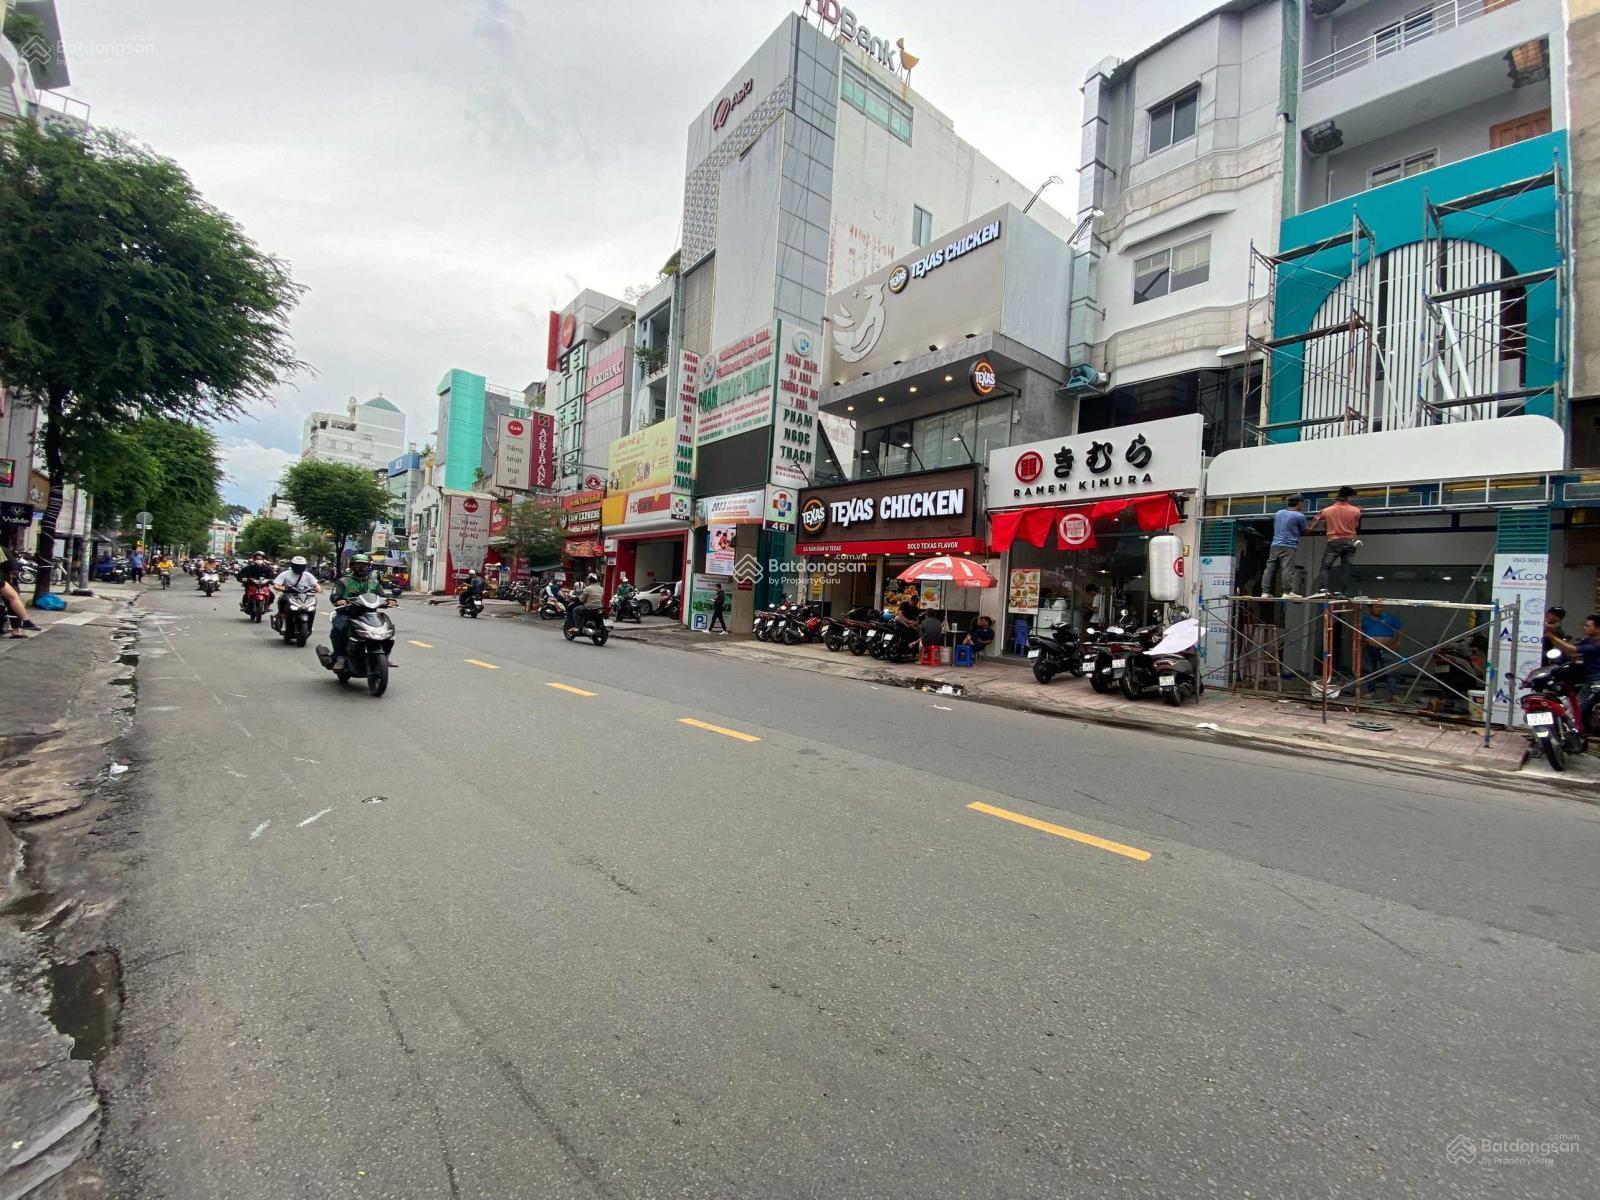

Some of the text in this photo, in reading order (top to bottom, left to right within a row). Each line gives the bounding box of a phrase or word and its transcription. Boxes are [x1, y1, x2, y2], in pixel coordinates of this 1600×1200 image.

[910, 220, 1001, 279] TEXAS CHICKEN
[888, 270, 907, 288] TEXAS
[974, 371, 995, 385] TEXAS
[782, 408, 813, 428] PHẠM
[784, 428, 810, 446] NGỌC
[537, 428, 547, 487] AGRIBANK
[780, 446, 812, 464] THẠCH
[1054, 433, 1153, 478] きむら
[1013, 473, 1153, 497] RAMEN KIMURA
[801, 507, 825, 525] TEXAS
[830, 489, 964, 527] TEXAS CHICKEN
[772, 522, 789, 531] 461
